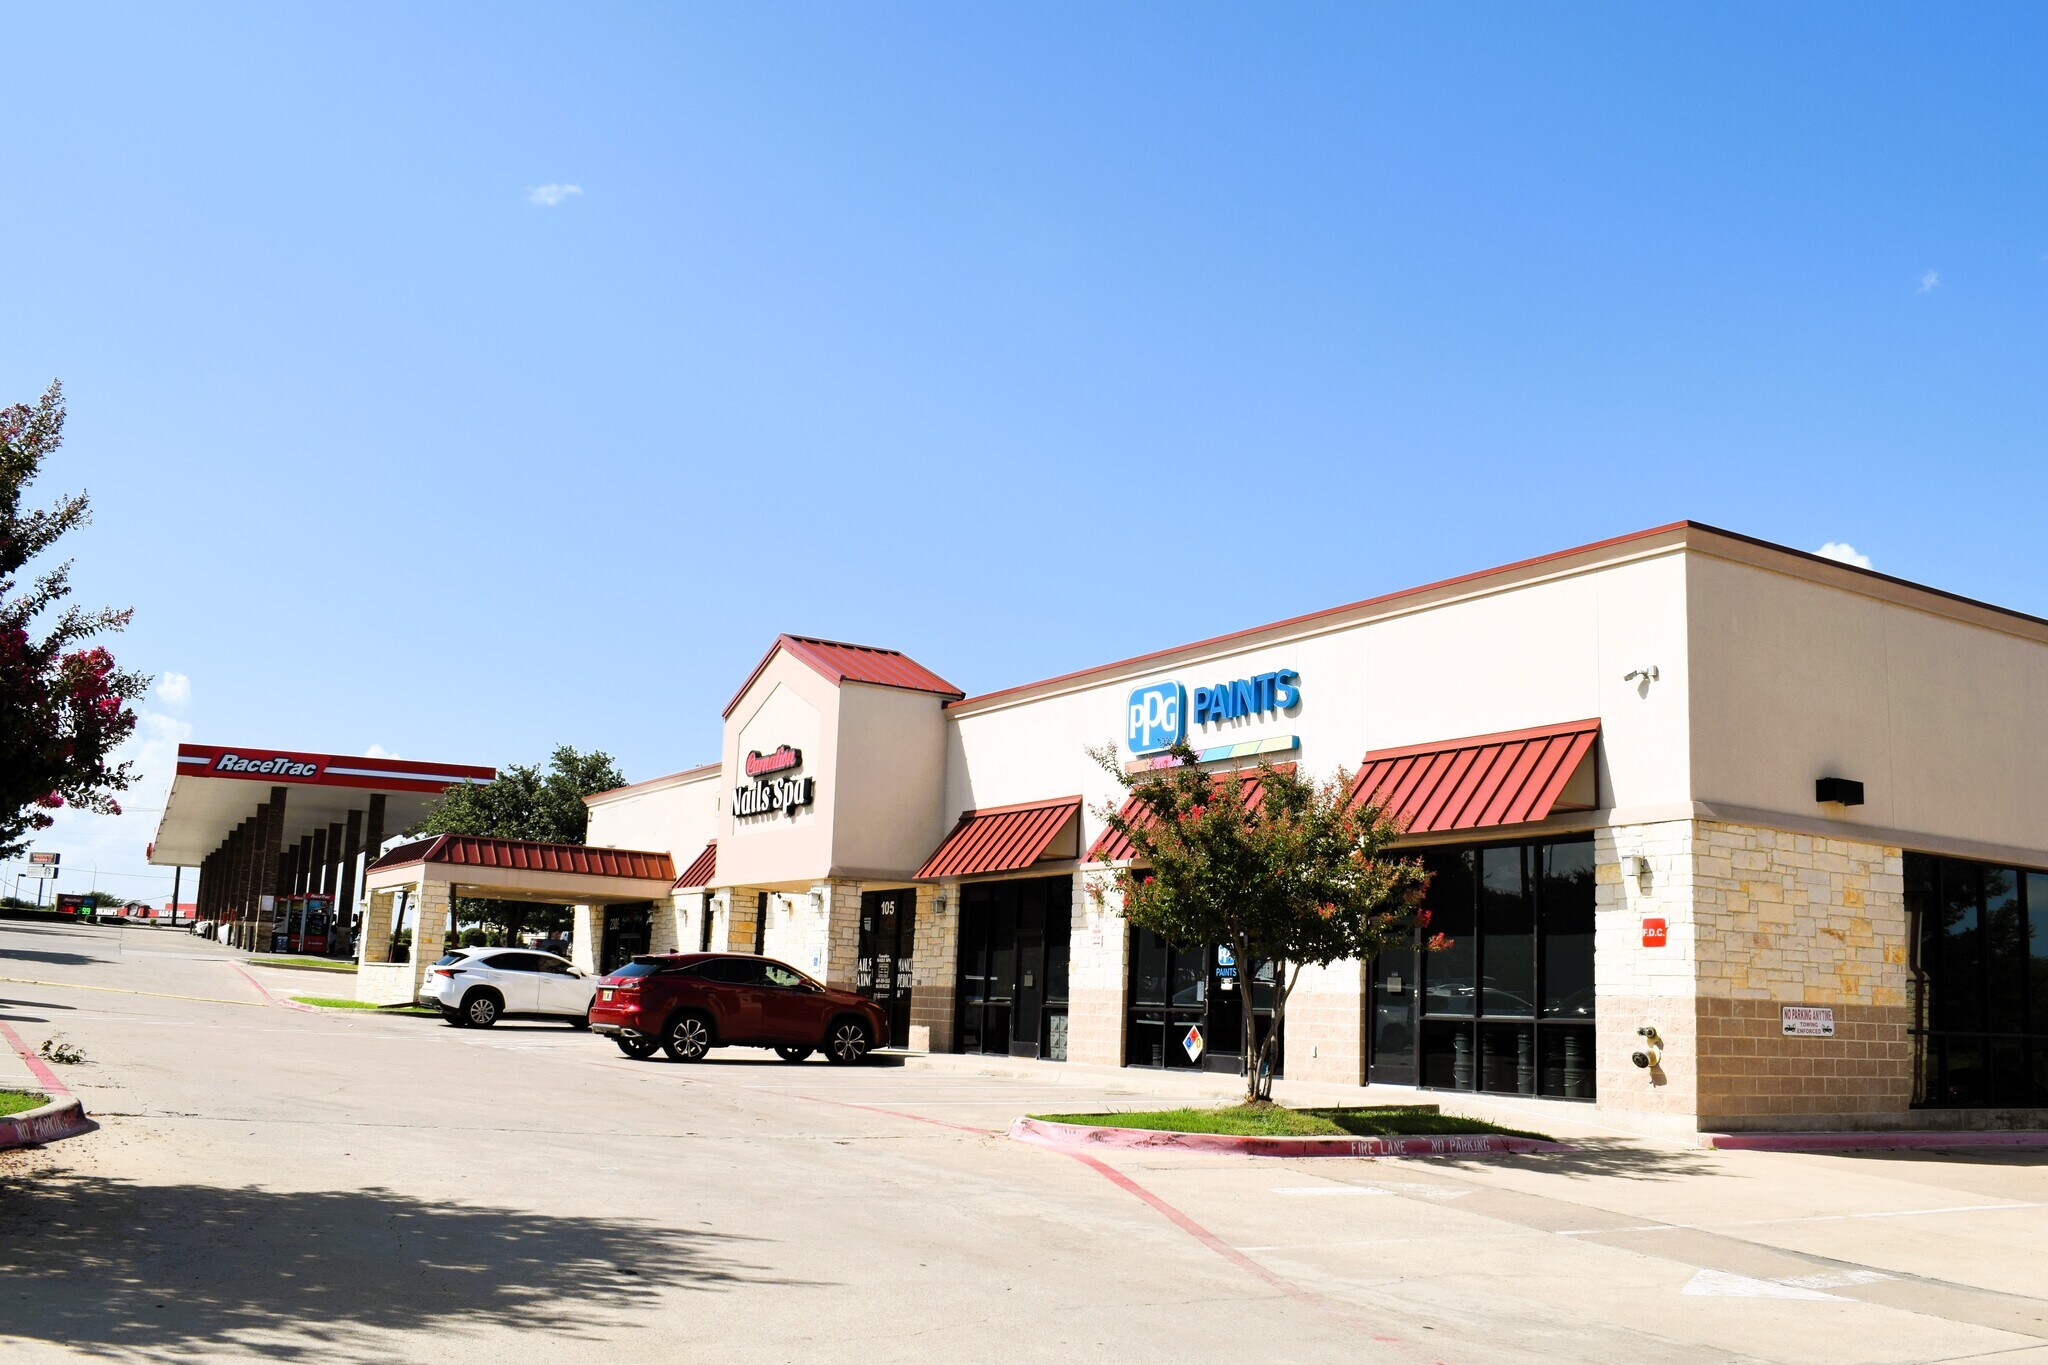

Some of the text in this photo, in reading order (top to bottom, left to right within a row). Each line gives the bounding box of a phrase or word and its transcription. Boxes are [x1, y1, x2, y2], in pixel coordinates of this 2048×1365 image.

[1194, 668, 1299, 724] PAINTS
[216, 753, 317, 776] RaceTrac
[731, 777, 808, 816] Nails Spa
[881, 901, 895, 915] 105
[1643, 928, 1666, 937] F.D.C.
[1216, 968, 1237, 977] PAINTS
[1784, 1009, 1791, 1020] NO
[1792, 1009, 1811, 1020] PARKING
[15, 1115, 70, 1141] NO PARKING
[1351, 1139, 1490, 1156] FIRE LANE NO PARKING
